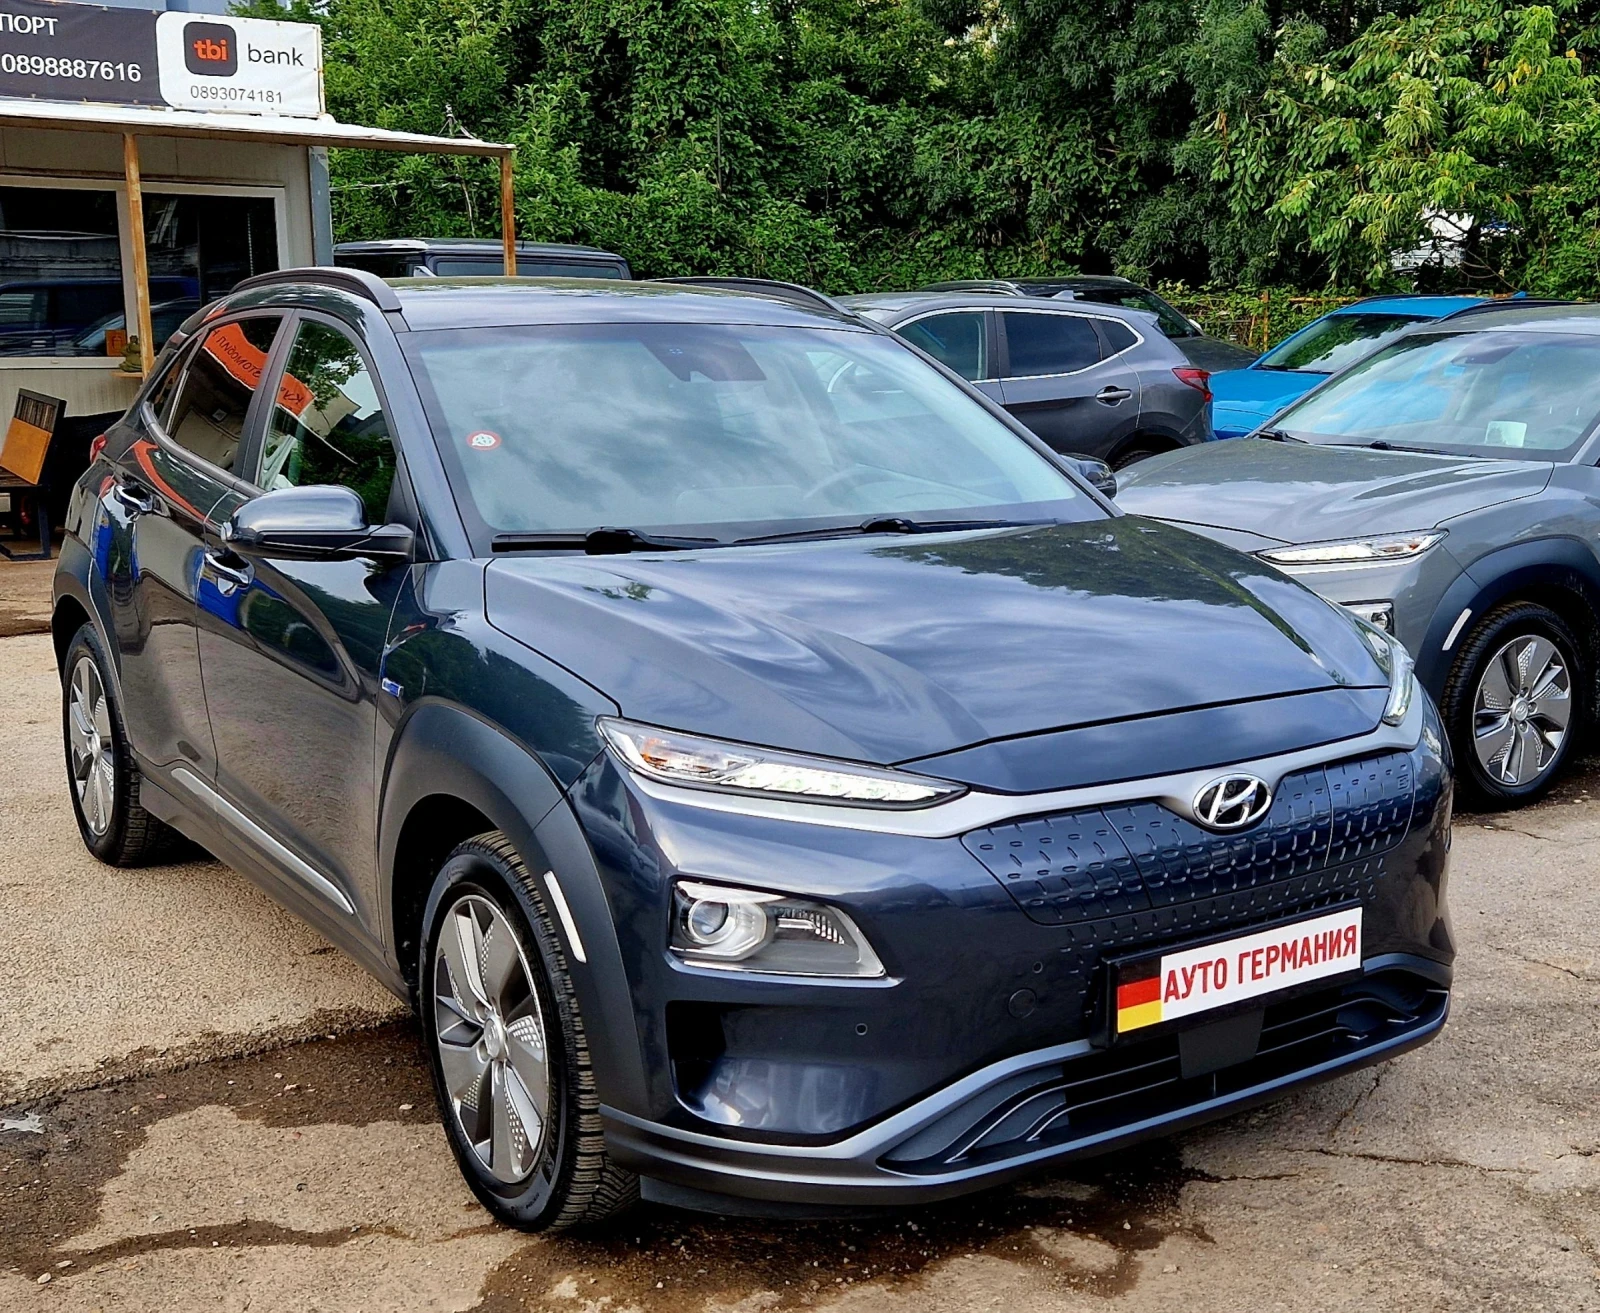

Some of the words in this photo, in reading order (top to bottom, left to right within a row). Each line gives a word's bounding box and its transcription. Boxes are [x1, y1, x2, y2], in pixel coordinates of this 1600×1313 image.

[193, 38, 229, 61] tbi
[247, 42, 304, 67] bank
[1, 53, 142, 82] 0898887616
[190, 85, 282, 104] 0893074181
[1164, 957, 1227, 1004] АУТО
[1237, 924, 1358, 985] ГЕРМАНИЯ
